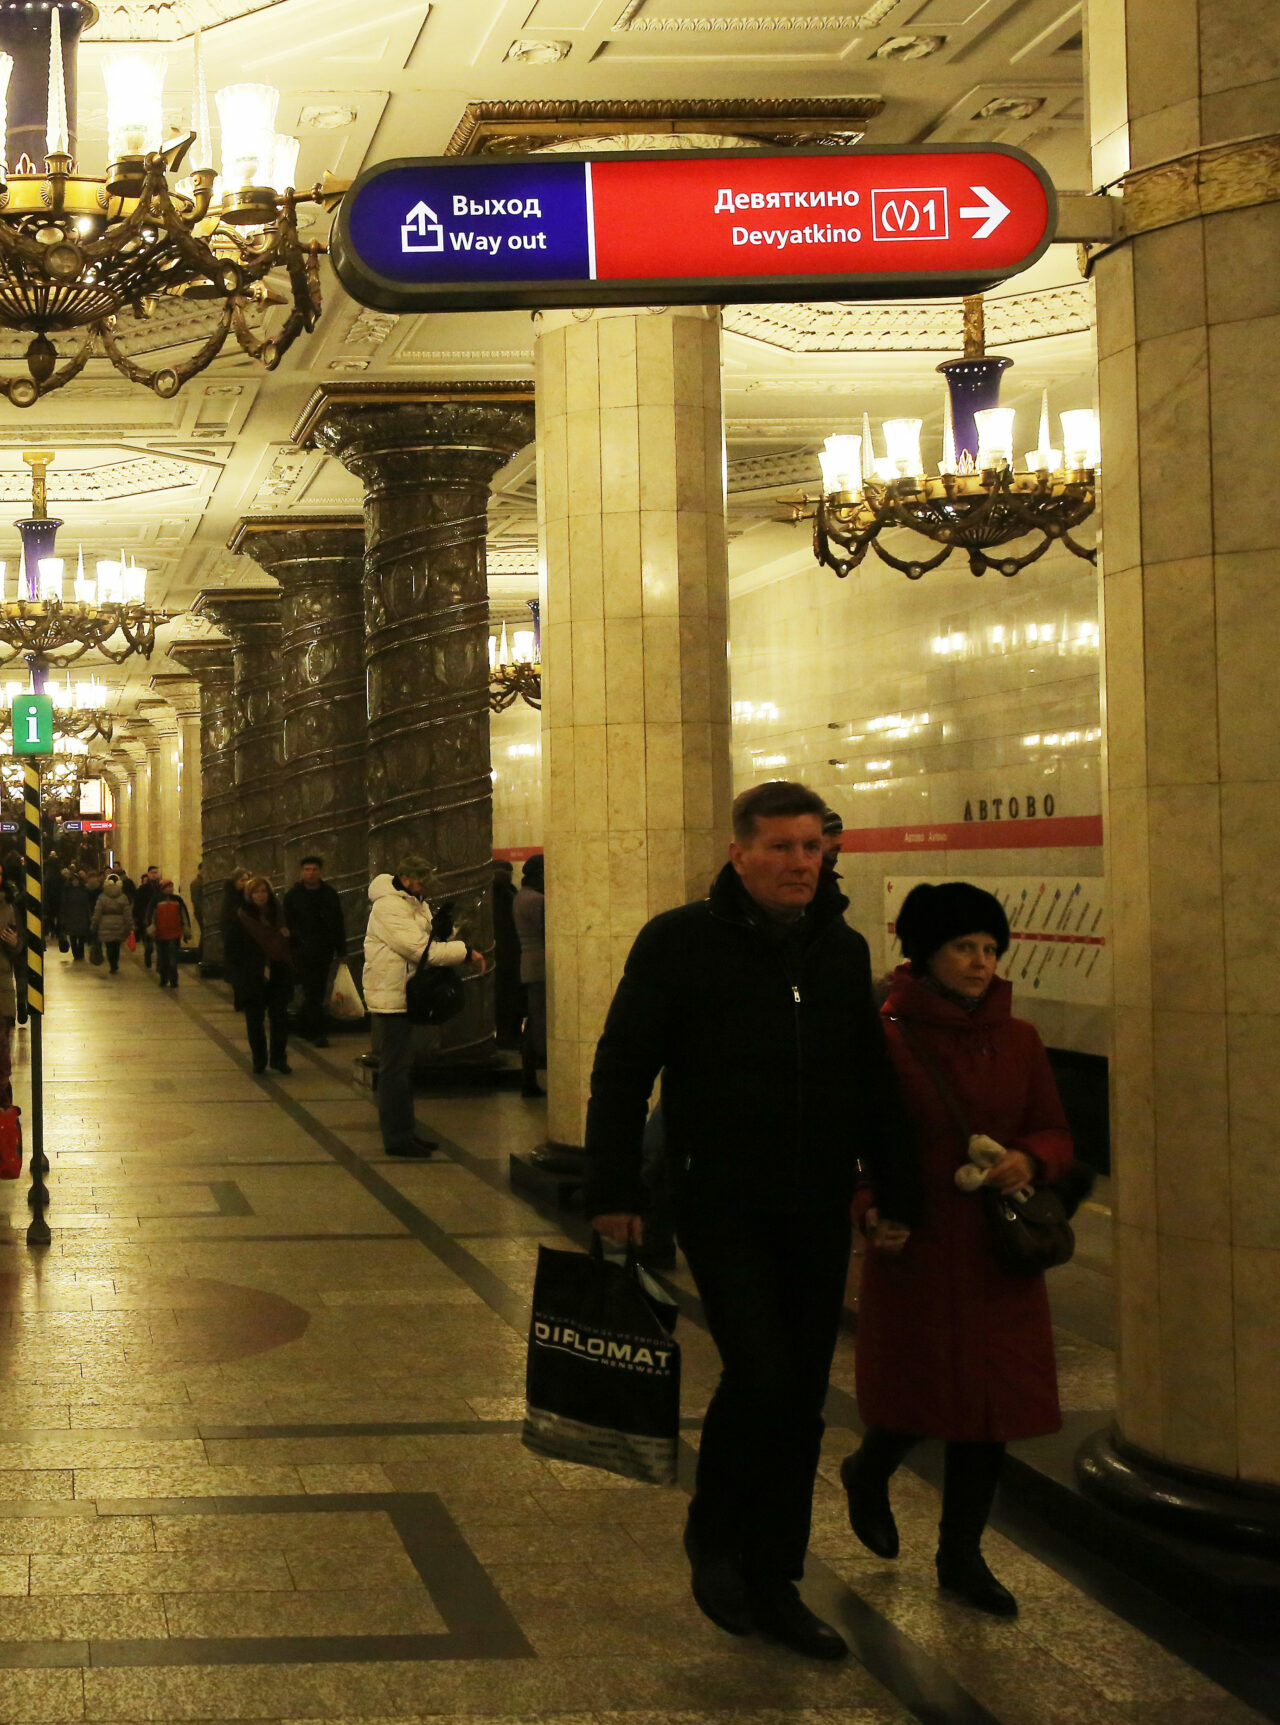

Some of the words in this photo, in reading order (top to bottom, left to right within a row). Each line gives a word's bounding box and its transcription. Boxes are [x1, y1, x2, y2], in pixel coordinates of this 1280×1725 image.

[452, 195, 542, 218] Выход
[714, 188, 860, 214] Девяткино
[449, 232, 502, 256] Way
[508, 232, 547, 249] out
[732, 224, 861, 249] Devyatkino
[963, 793, 1055, 822] АВТОВО
[535, 1321, 672, 1368] DIPLOMAT
